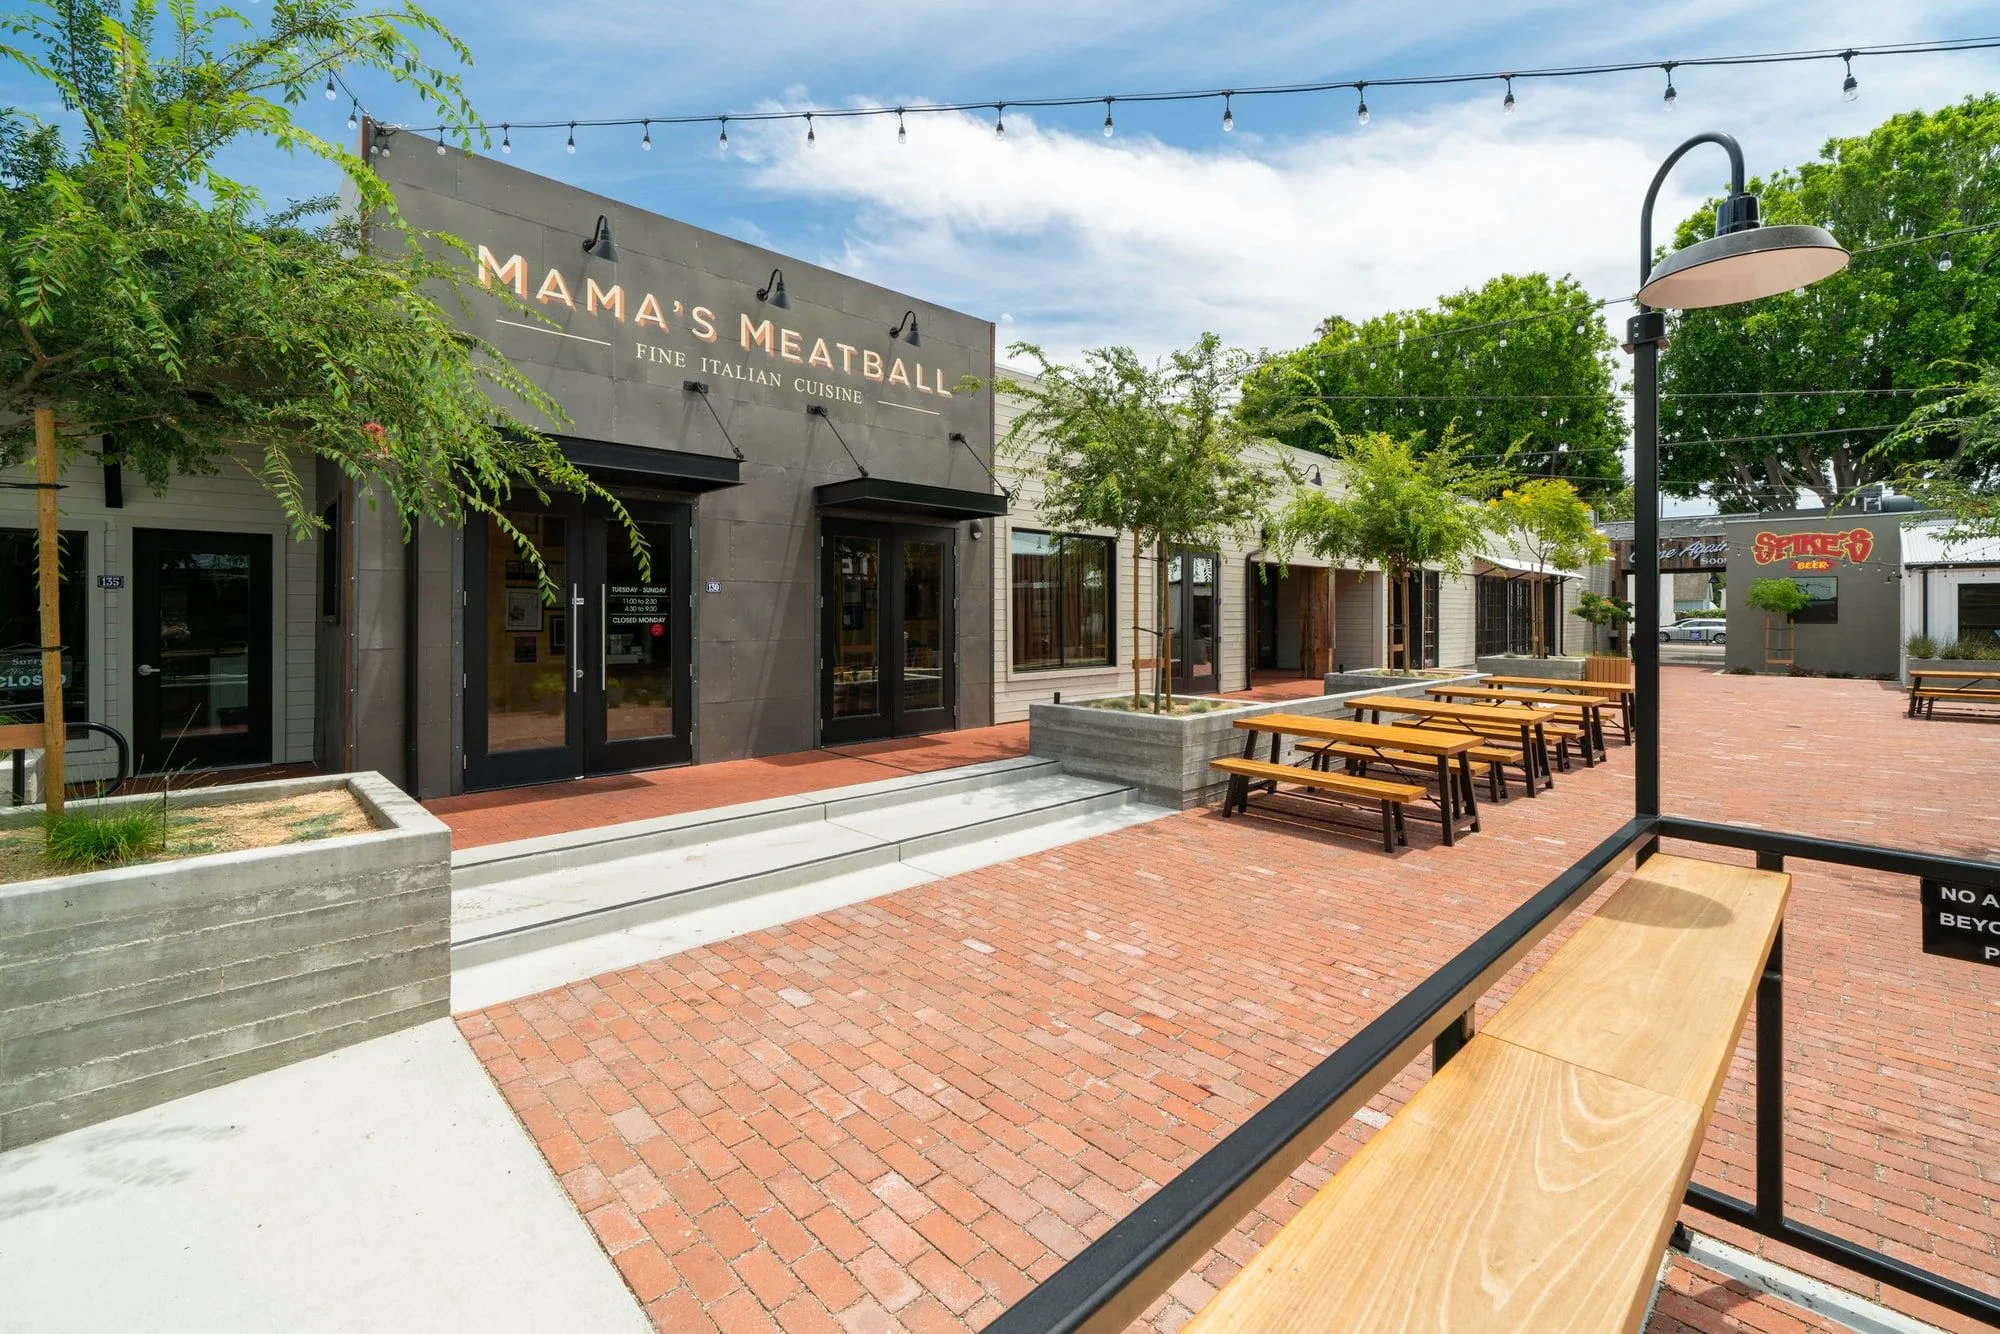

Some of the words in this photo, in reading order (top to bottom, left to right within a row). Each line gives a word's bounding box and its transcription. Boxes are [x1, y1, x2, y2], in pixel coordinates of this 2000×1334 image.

[740, 312, 953, 398] MEATBALL
[635, 343, 687, 368] FINE
[701, 357, 782, 387] ITALIAN
[794, 378, 863, 404] CUISINE
[1751, 527, 1874, 565] SPIKE'S
[1796, 560, 1828, 570] BEER
[102, 577, 120, 586] 135
[642, 586, 667, 594] SUNDAY
[1941, 886, 1976, 904] NO
